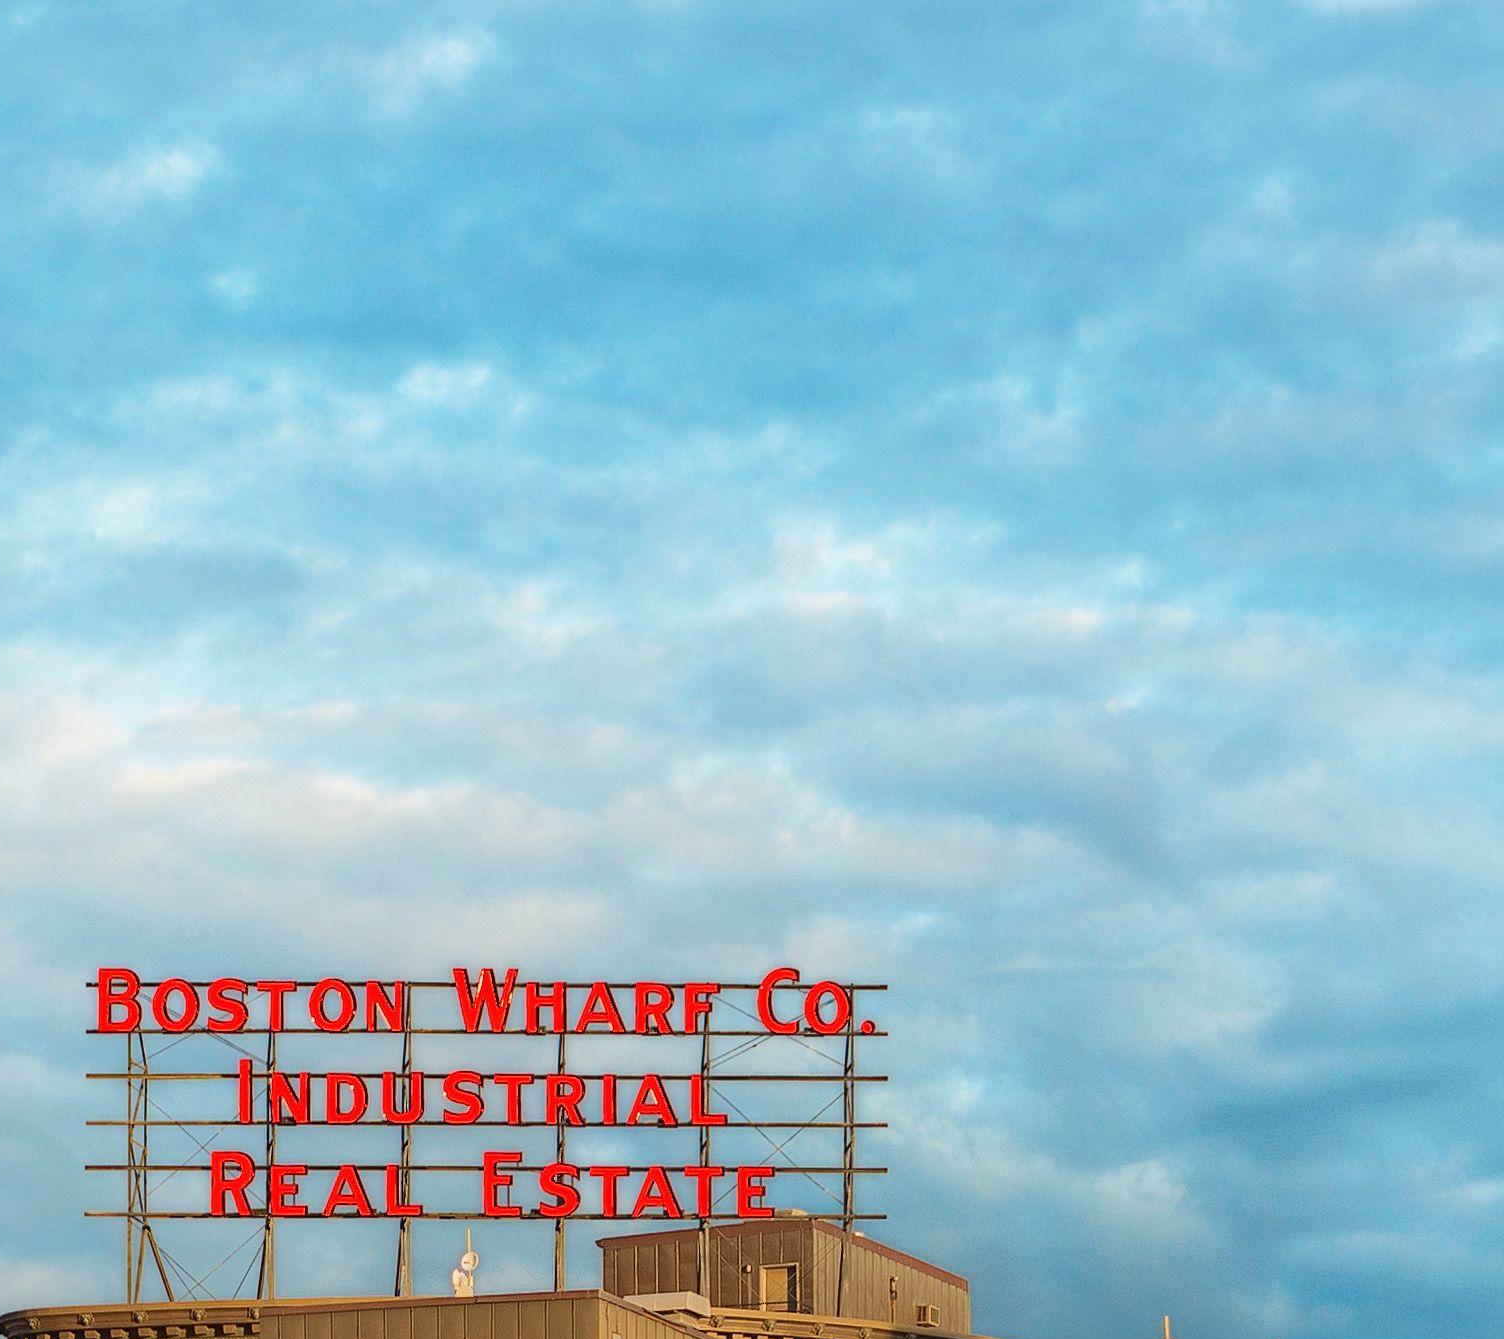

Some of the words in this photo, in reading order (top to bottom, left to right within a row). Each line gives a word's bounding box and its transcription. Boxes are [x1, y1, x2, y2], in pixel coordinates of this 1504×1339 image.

[96, 967, 405, 1034] BOSTON
[451, 967, 720, 1035] WHARF
[756, 967, 875, 1036] CO.
[236, 1057, 728, 1127] INDUSTRIAL
[209, 1150, 425, 1217] REAL
[481, 1150, 775, 1219] ESTATE
